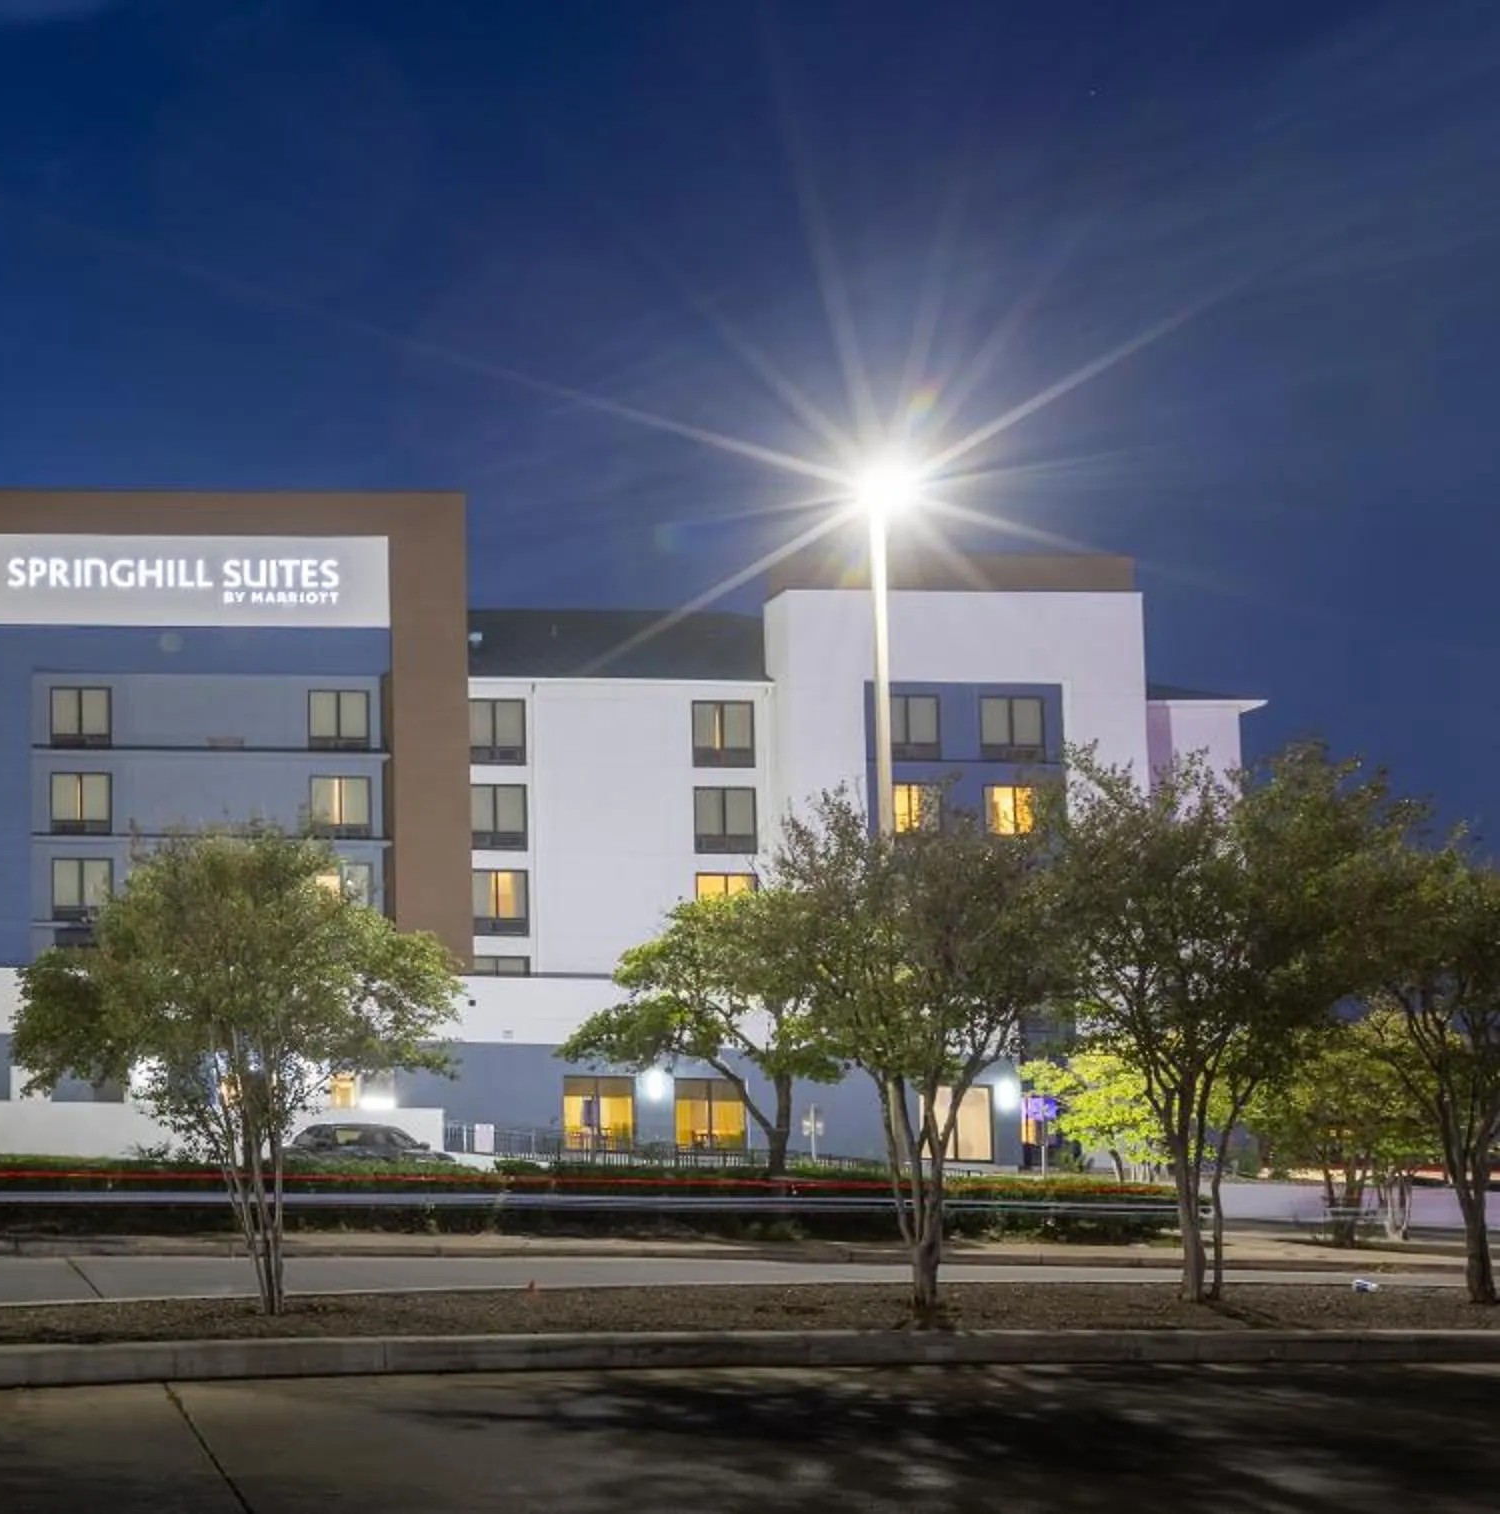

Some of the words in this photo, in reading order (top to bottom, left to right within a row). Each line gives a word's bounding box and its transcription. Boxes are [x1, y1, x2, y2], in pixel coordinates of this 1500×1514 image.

[6, 557, 214, 589] SPRINGHILL
[222, 558, 340, 589] SUITES
[222, 591, 246, 605] BY
[251, 591, 340, 605] MARRIOTT
